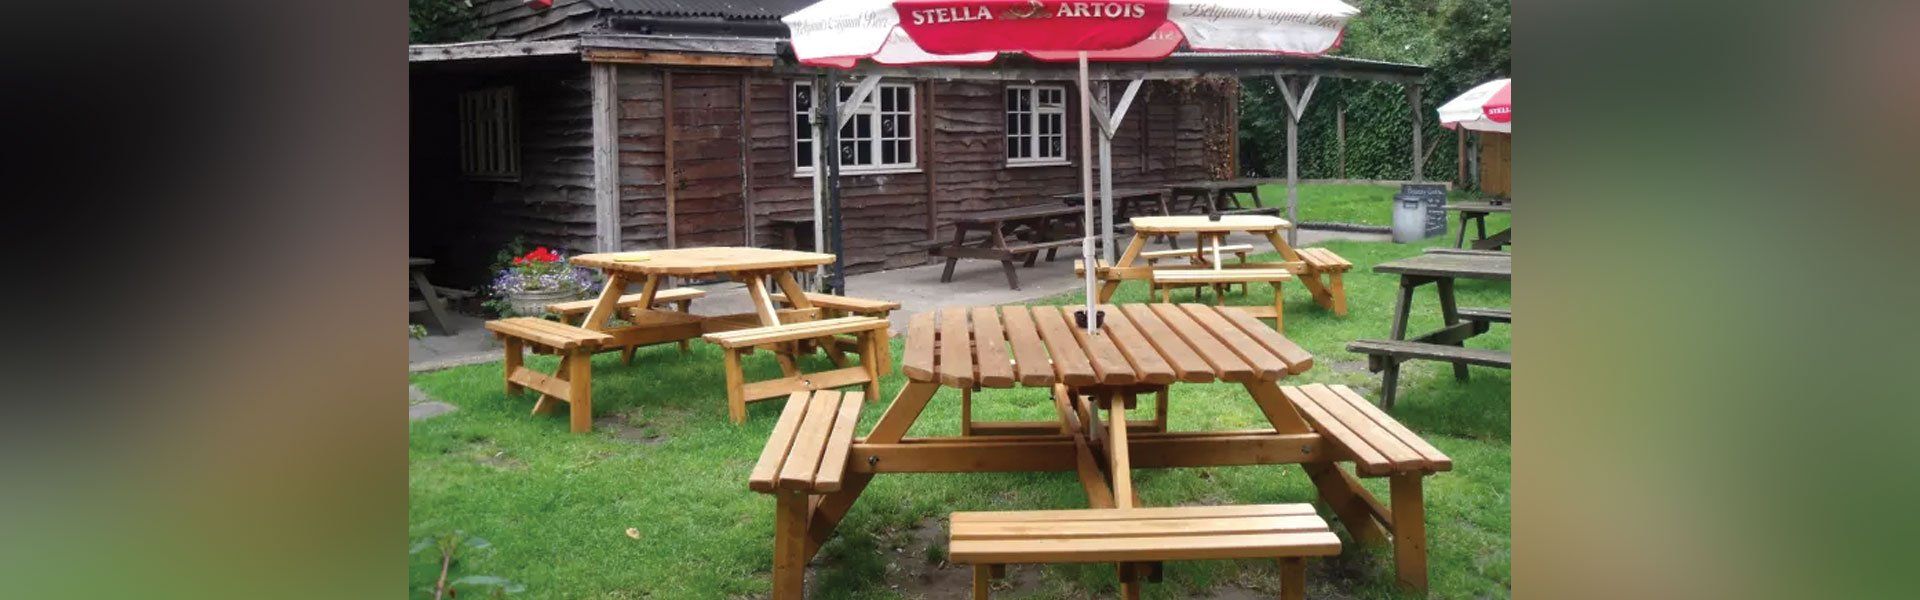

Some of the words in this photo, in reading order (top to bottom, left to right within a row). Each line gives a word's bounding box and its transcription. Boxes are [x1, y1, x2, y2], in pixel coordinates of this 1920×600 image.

[912, 6, 993, 25] STELLA
[1056, 2, 1145, 18] ARTOIS
[1488, 106, 1511, 115] STELL
